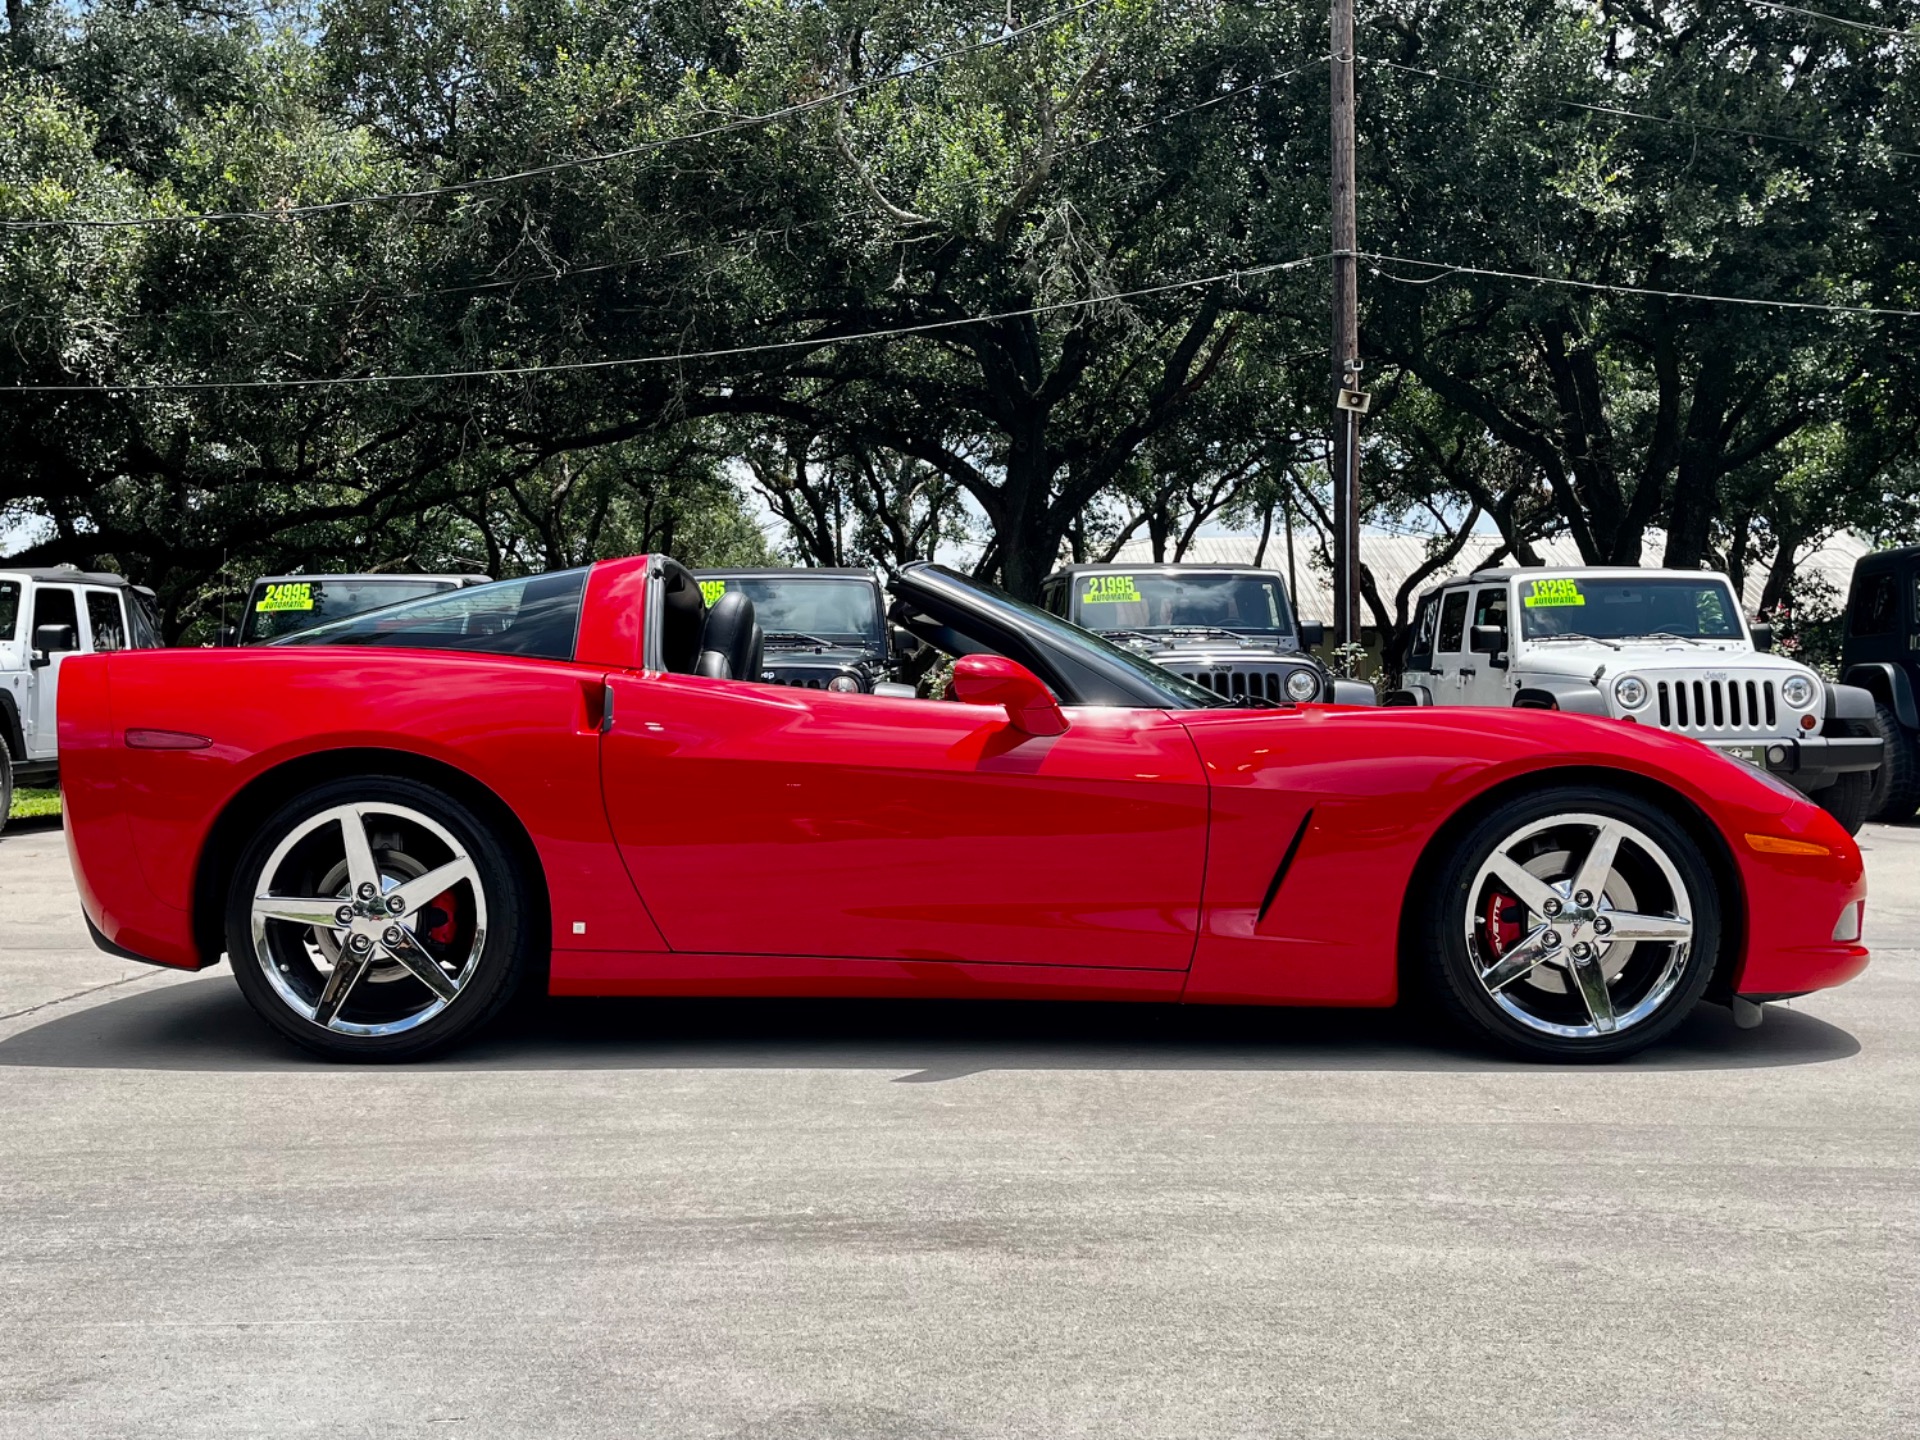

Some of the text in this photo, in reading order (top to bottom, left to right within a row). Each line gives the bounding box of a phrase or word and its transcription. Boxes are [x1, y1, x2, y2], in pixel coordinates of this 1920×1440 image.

[265, 583, 311, 601] 24995
[700, 581, 725, 600] 995
[1089, 576, 1134, 593] 21995
[1531, 579, 1576, 597] 13295
[264, 600, 305, 609] AUTOMATIC
[1092, 593, 1133, 602] AUTOMATIC
[1534, 597, 1576, 606] AUTOMATIC
